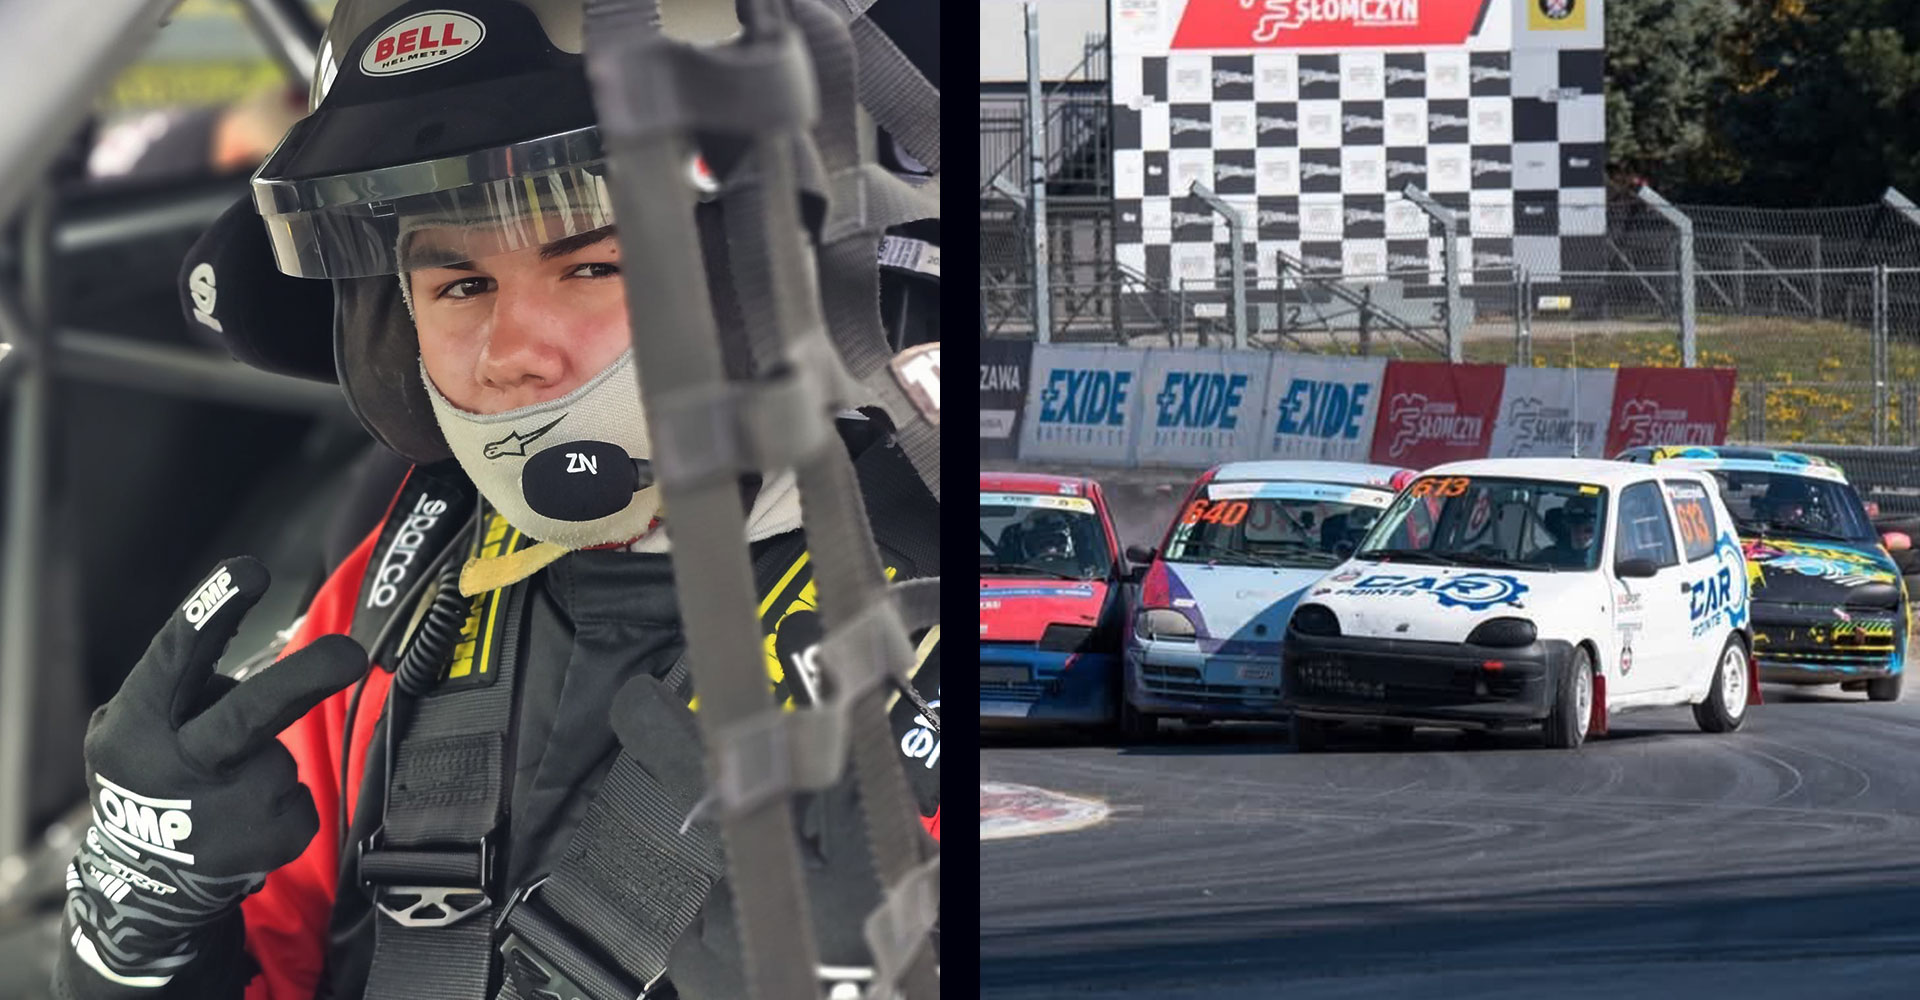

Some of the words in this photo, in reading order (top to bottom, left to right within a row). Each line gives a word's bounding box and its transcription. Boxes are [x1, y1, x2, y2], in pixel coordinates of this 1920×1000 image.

[374, 23, 462, 63] BELL
[382, 49, 448, 69] HELMETS
[1040, 369, 1131, 426] EXIDE
[1156, 372, 1248, 429] EXIDE
[1276, 379, 1369, 440] EXIDE
[1184, 498, 1248, 526] 640
[1412, 477, 1470, 499] 613
[1676, 501, 1711, 546] 613
[368, 493, 447, 608] sparco
[185, 571, 232, 624] OMP
[1354, 574, 1490, 595] CAR
[1690, 566, 1731, 621] CAR
[100, 787, 192, 851] OMP
